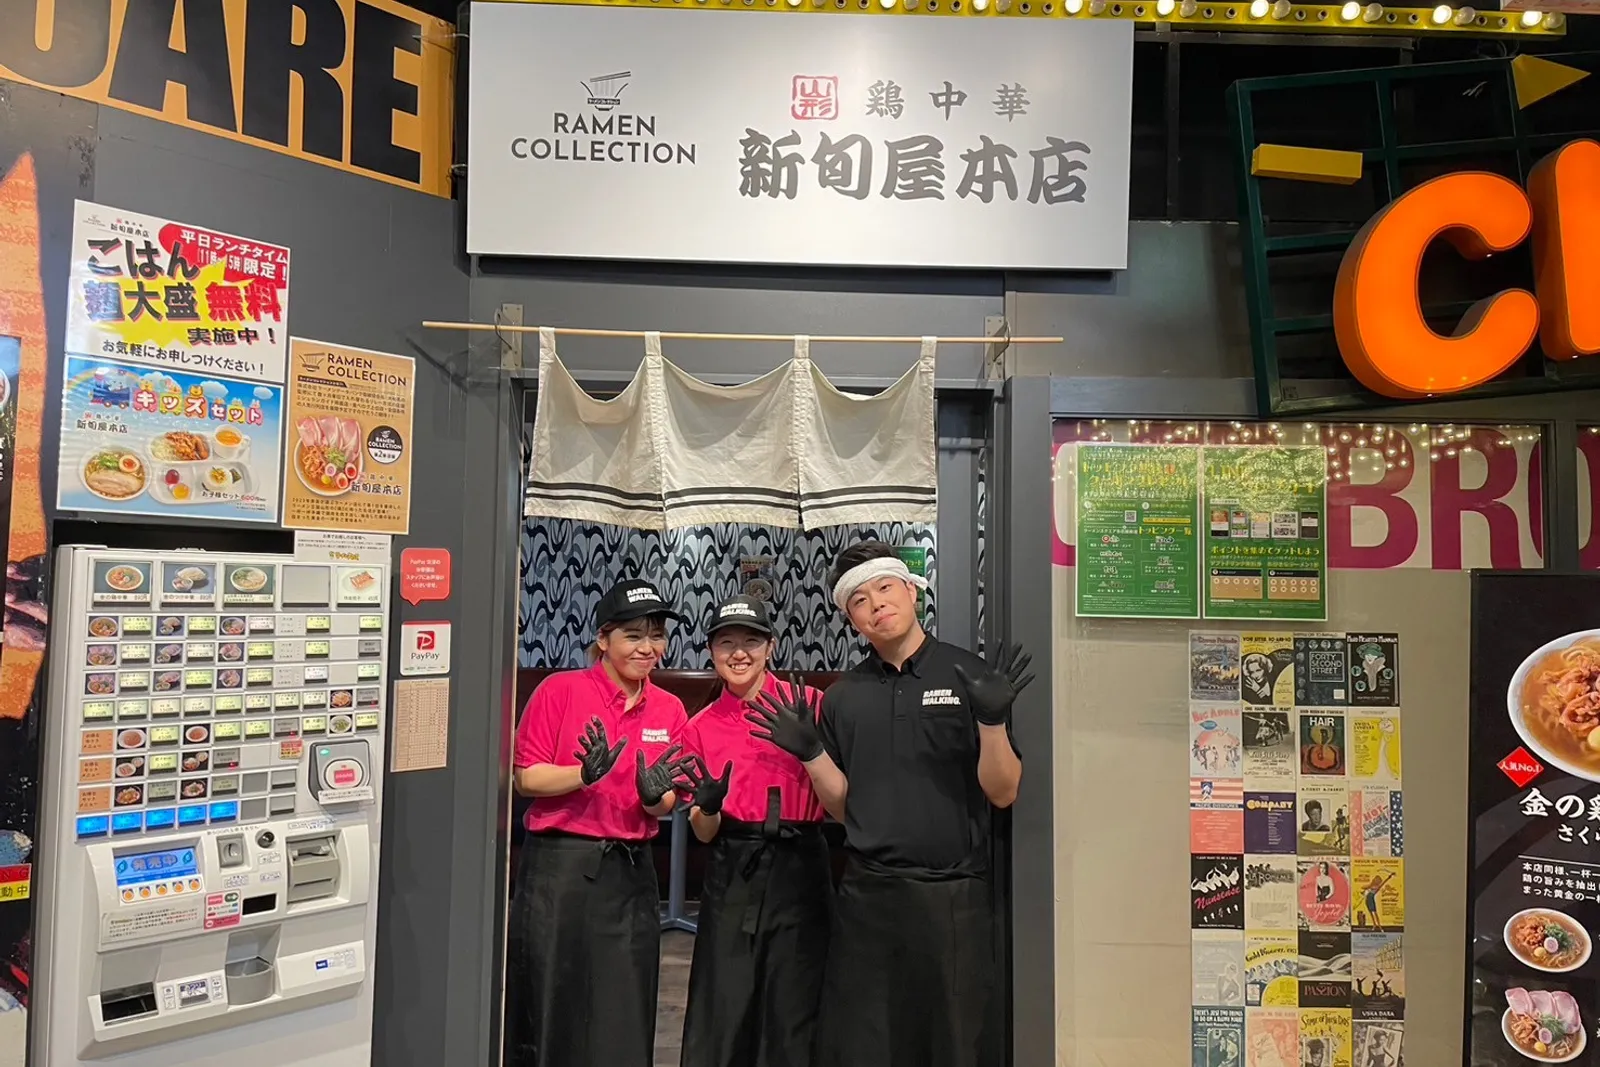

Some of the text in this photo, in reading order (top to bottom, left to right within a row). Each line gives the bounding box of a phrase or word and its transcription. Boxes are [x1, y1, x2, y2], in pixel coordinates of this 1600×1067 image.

[795, 78, 835, 117] 山形
[865, 80, 1031, 122] 鶏中華
[553, 113, 656, 137] RAMEN
[511, 137, 697, 165] COLLECTION
[738, 127, 1092, 205] 新旬屋本店
[181, 229, 288, 264] 平日ランチタイム
[87, 238, 201, 281] ごはん
[205, 281, 283, 322] 無料
[327, 353, 373, 369] RAMEN
[327, 366, 407, 386] COLLECTION
[135, 390, 262, 424] キッズセット
[410, 652, 440, 661] PayPay
[1310, 653, 1336, 661] FORTY
[1311, 660, 1342, 668] SECOND
[922, 696, 961, 706] WALKING.
[923, 689, 952, 698] RAMEN
[1309, 716, 1335, 727] HAIR
[1194, 887, 1240, 909] Nunsense
[1304, 985, 1347, 996] PASSION
